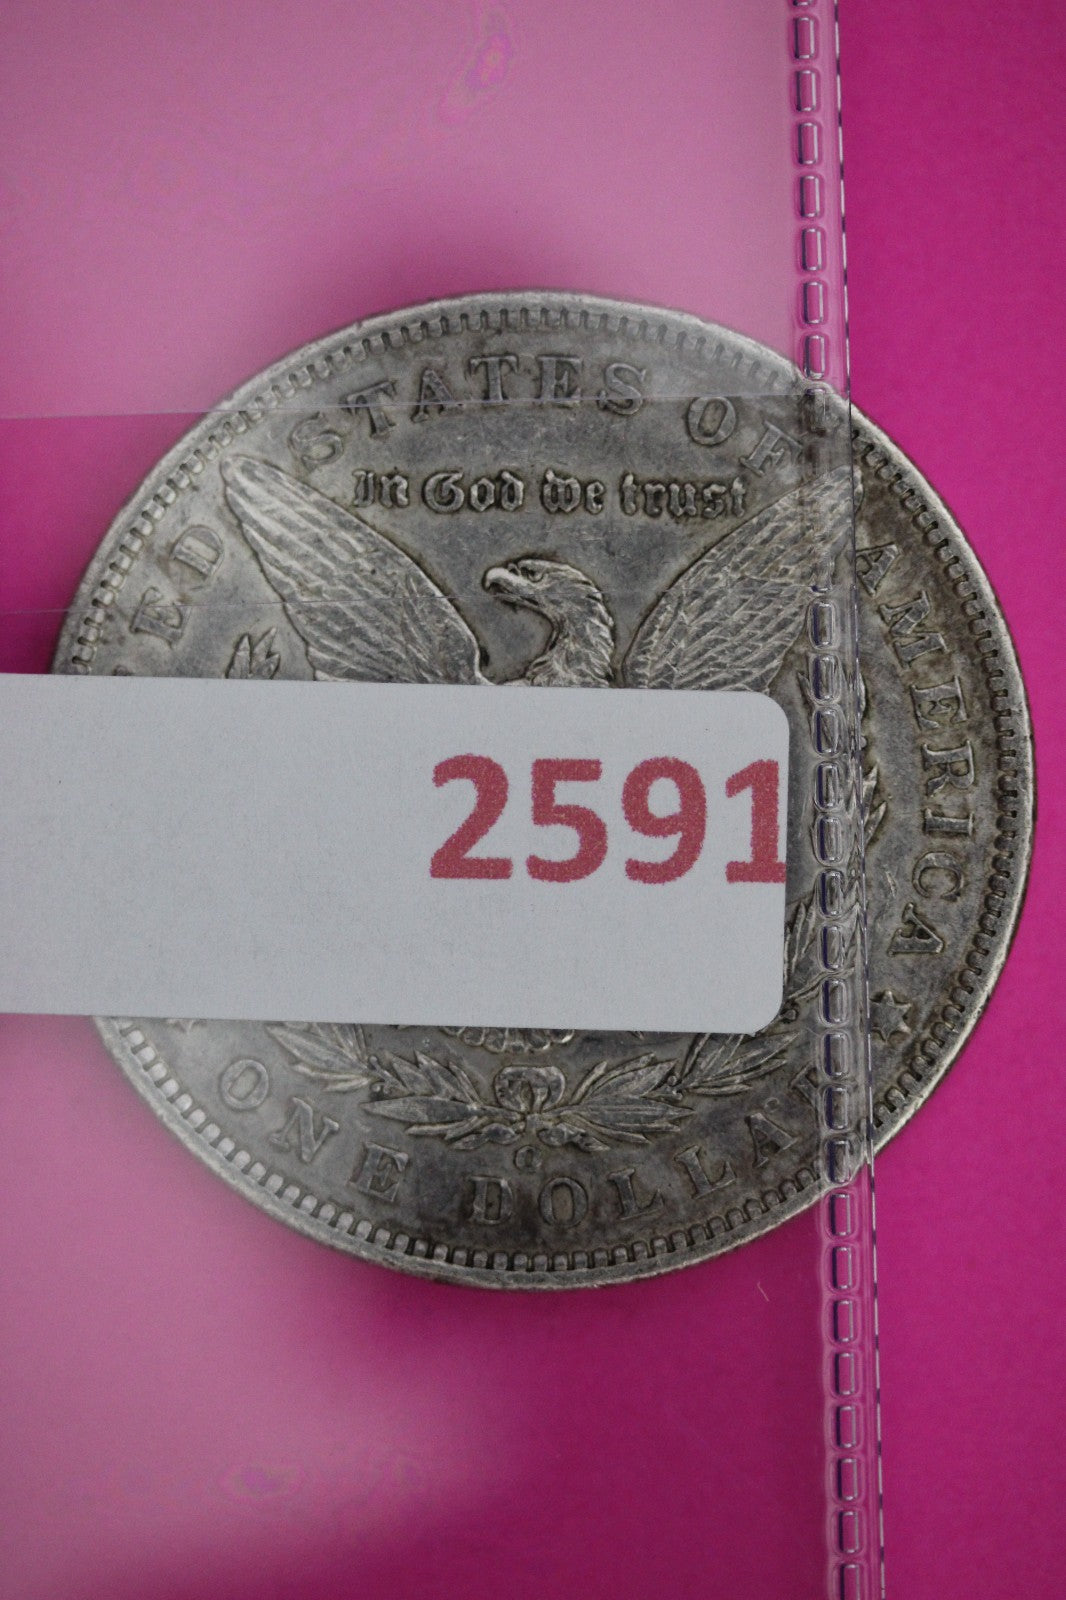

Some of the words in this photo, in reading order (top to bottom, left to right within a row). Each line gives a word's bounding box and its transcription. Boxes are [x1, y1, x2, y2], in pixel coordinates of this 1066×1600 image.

[289, 353, 646, 472] STATES
[686, 395, 804, 478] OF
[352, 469, 409, 509] In
[423, 469, 525, 513] God
[541, 466, 605, 516] we
[618, 471, 748, 519] trust
[854, 541, 975, 956] AMERICA
[430, 754, 787, 884] 2591
[219, 1058, 410, 1202] ONE
